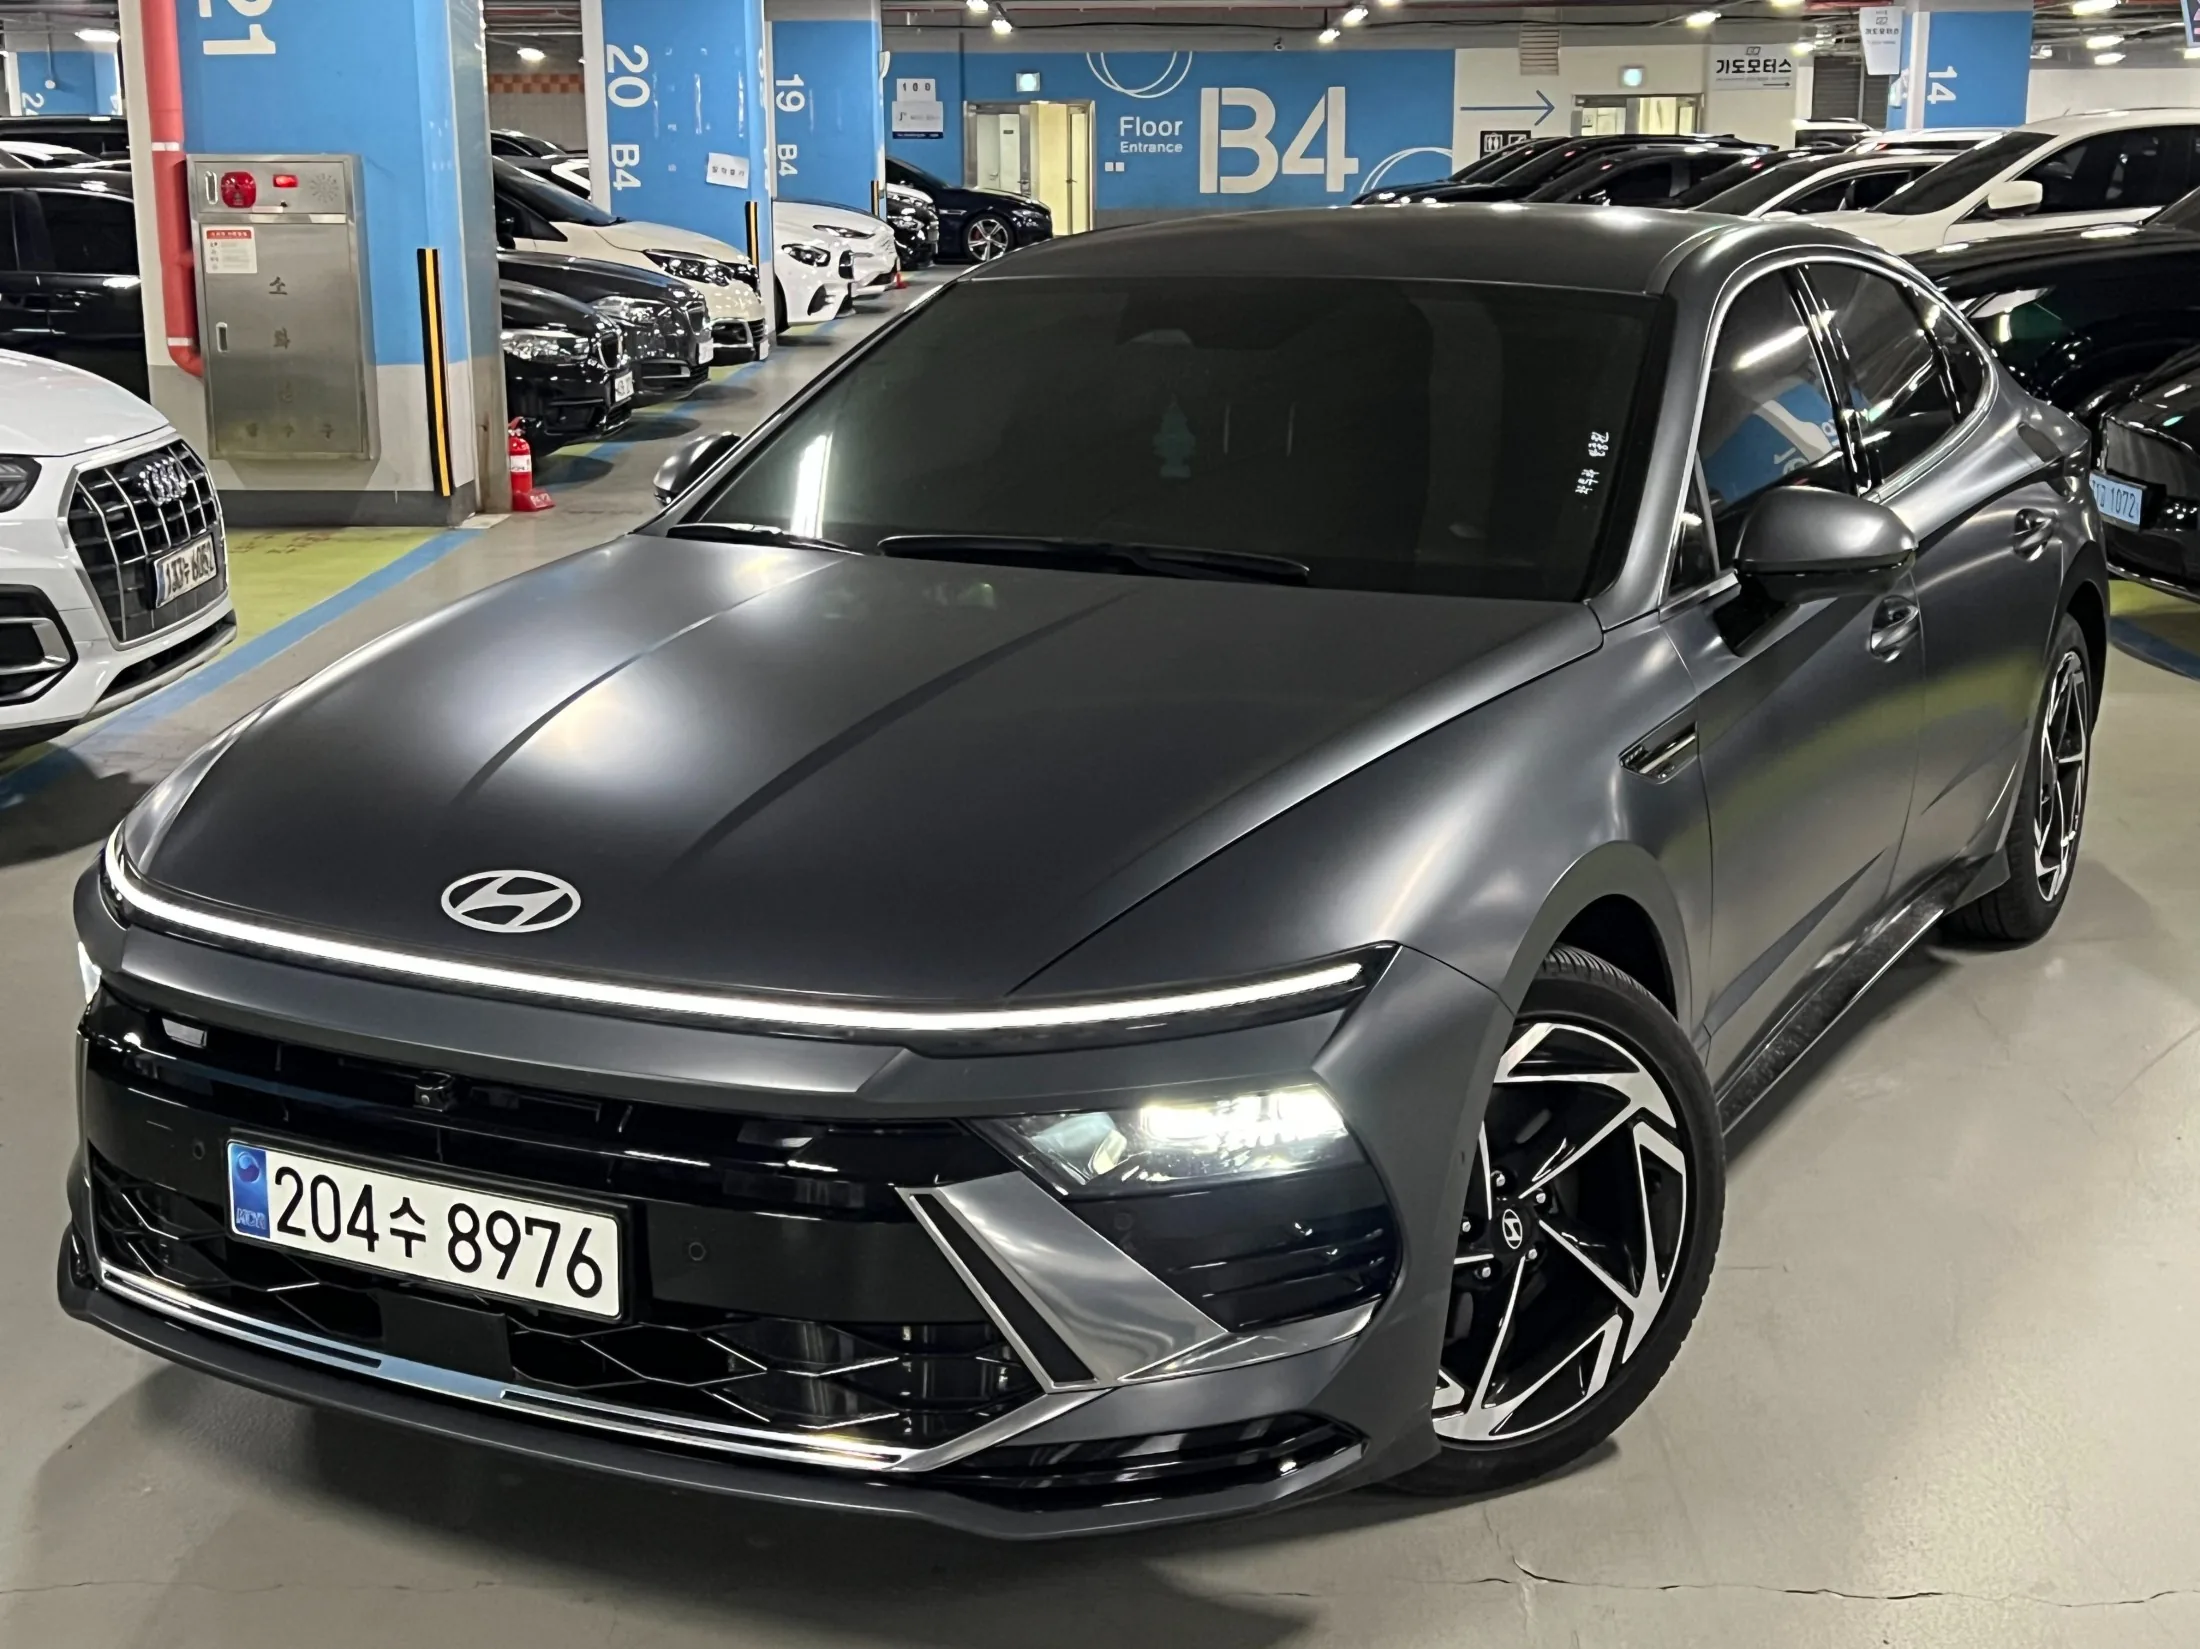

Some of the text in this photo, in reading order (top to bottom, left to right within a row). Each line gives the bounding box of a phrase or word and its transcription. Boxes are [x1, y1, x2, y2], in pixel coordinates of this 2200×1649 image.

[606, 44, 650, 108] 20
[1715, 58, 1792, 75] 기도모터스
[1926, 65, 1958, 105] 14
[775, 73, 806, 112] 19
[1120, 116, 1184, 137] Floor
[1200, 86, 1359, 194] B4
[777, 143, 798, 177] B4
[1120, 141, 1184, 154] Entrance
[610, 143, 642, 192] B4
[2111, 488, 2136, 519] 1072
[274, 1166, 603, 1298] 204수 8976
